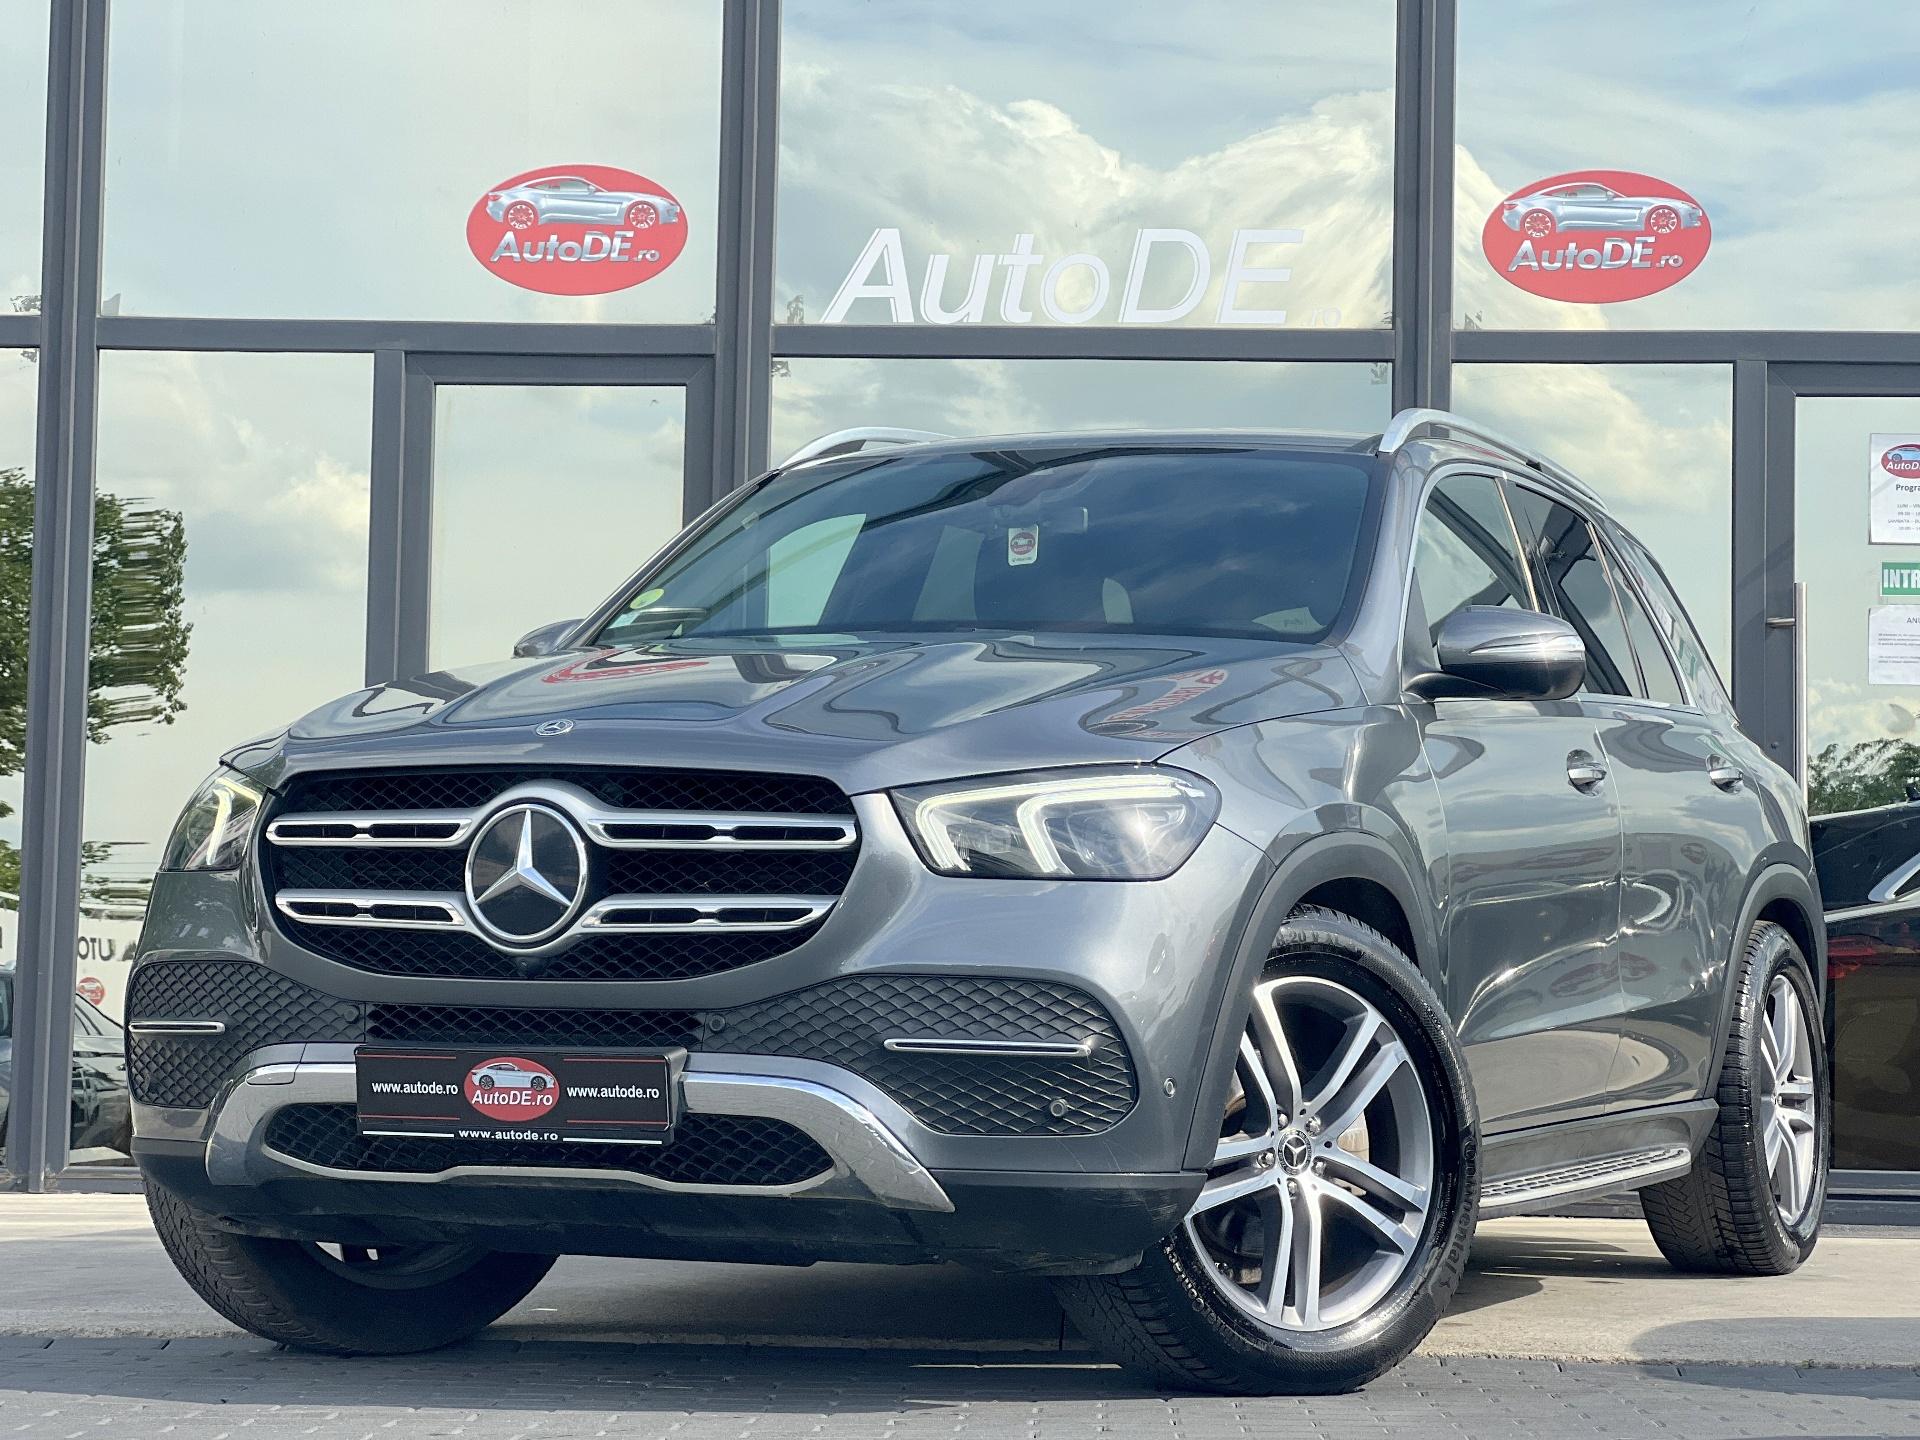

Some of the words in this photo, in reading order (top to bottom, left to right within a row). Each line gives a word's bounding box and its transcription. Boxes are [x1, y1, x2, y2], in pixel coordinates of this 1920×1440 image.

[1886, 461, 1920, 470] AutoD
[371, 1080, 459, 1095] www.autode.ro
[566, 1084, 660, 1099] www.autode.ro
[471, 1090, 553, 1107] AutoDE.ro
[458, 1128, 559, 1141] www.autode.ro
